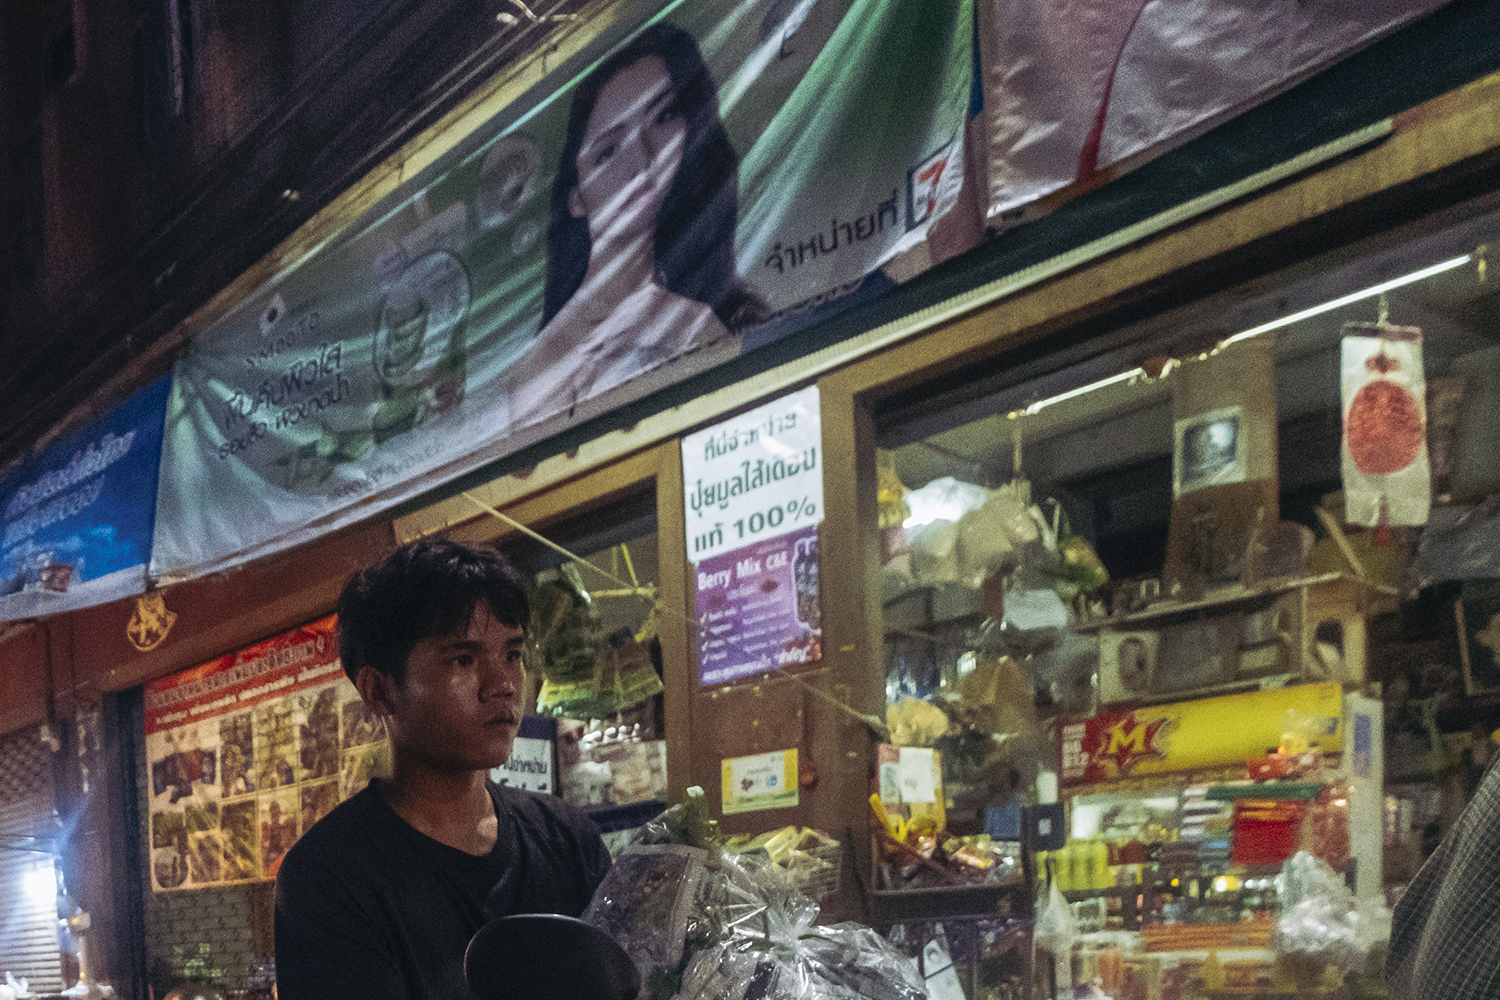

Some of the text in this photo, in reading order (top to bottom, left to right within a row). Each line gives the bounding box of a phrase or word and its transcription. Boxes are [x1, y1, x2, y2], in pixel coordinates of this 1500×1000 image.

[694, 522, 724, 553] แท้
[732, 496, 817, 539] 100%
[698, 569, 732, 591] Berry
[736, 556, 762, 579] Mix
